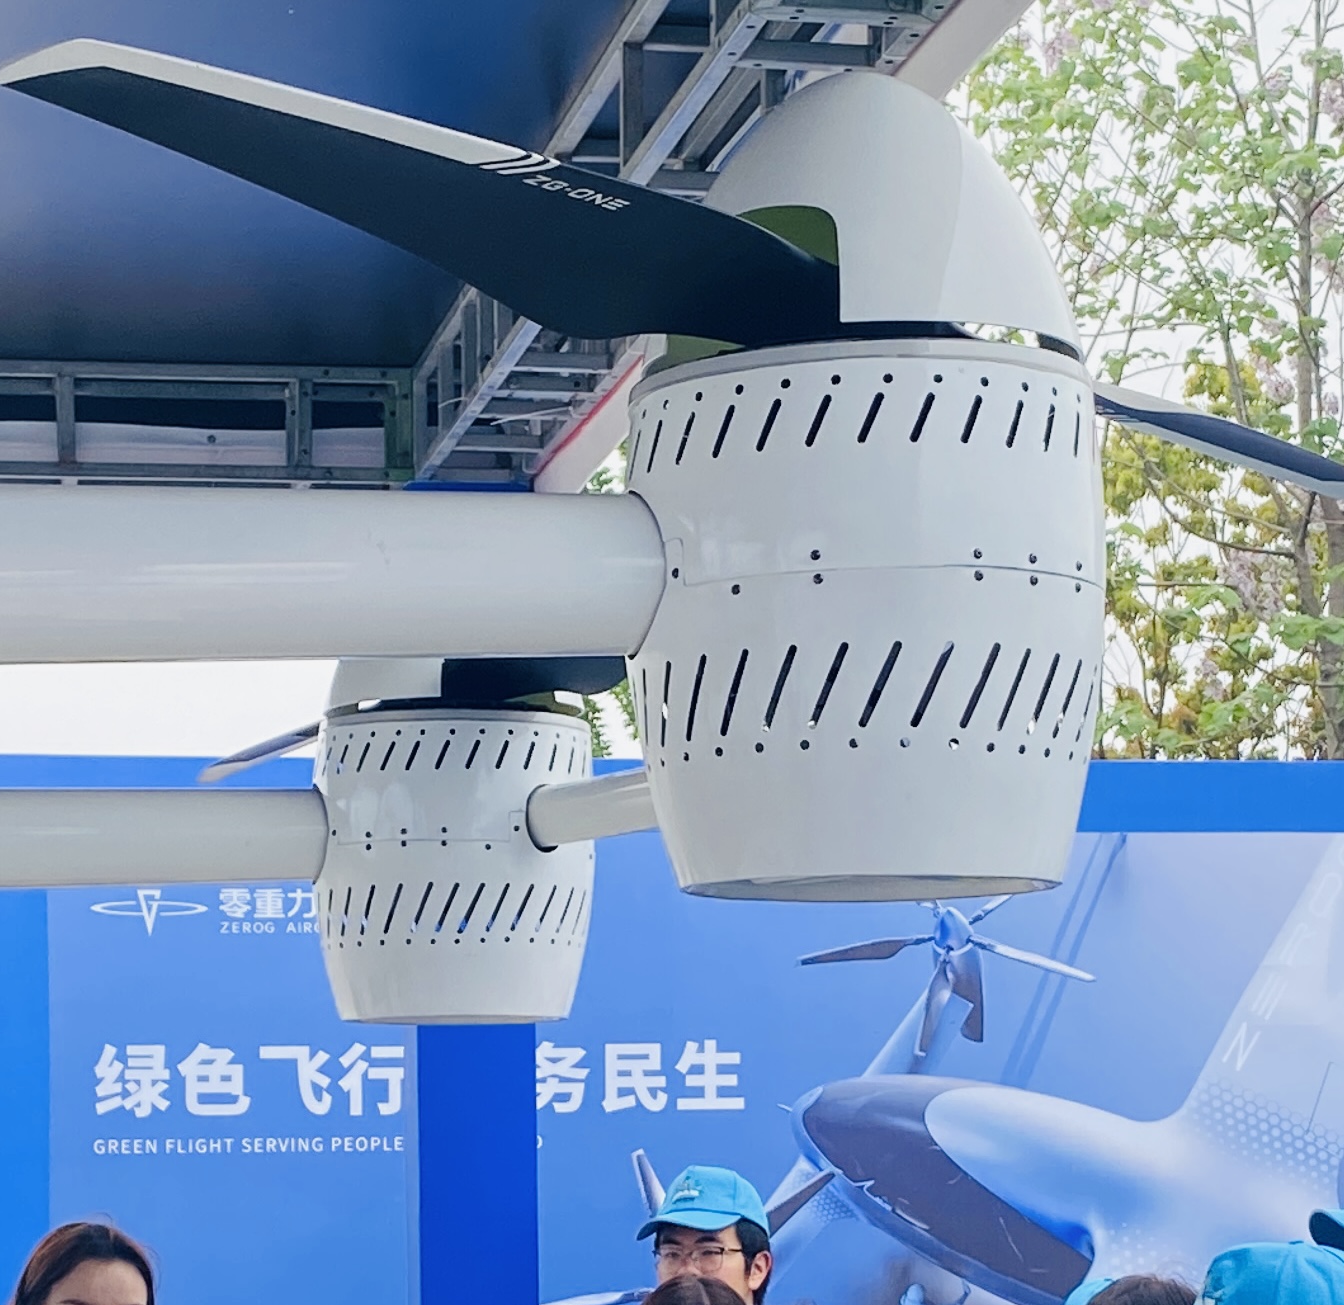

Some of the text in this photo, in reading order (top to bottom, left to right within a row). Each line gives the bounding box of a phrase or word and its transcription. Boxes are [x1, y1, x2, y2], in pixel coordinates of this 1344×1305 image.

[219, 888, 318, 918] 零重力
[219, 922, 275, 934] ZEROG
[94, 1039, 746, 1118] 绿色飞行 务民生
[93, 1136, 405, 1155] GREEN FLIGHT SERVING PEOPLE
